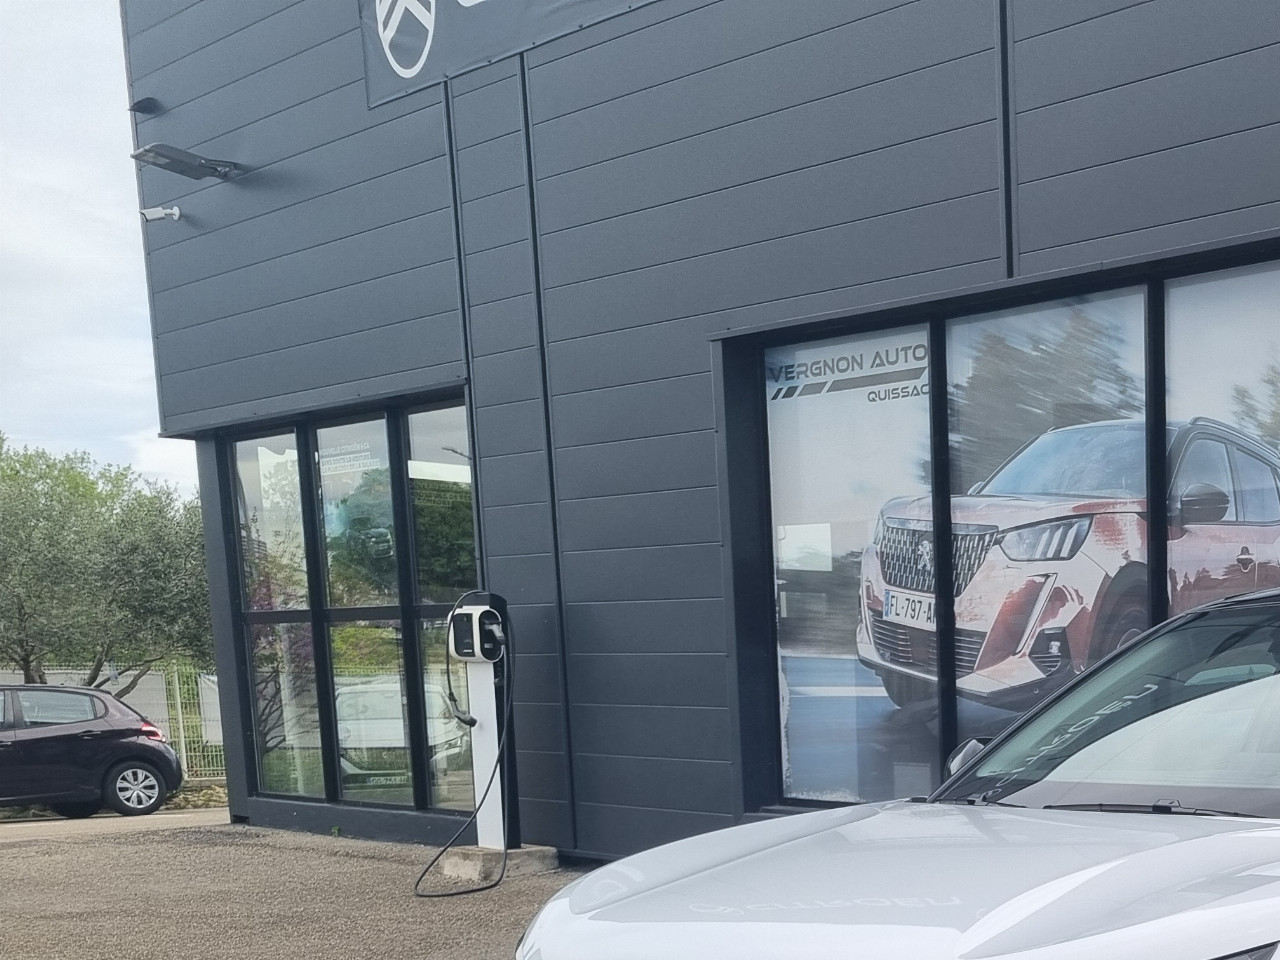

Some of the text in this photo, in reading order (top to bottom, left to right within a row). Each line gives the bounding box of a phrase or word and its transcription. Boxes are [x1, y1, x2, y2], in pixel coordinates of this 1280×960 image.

[769, 343, 929, 383] VERGNON AUTO
[867, 384, 929, 402] QUISSAC
